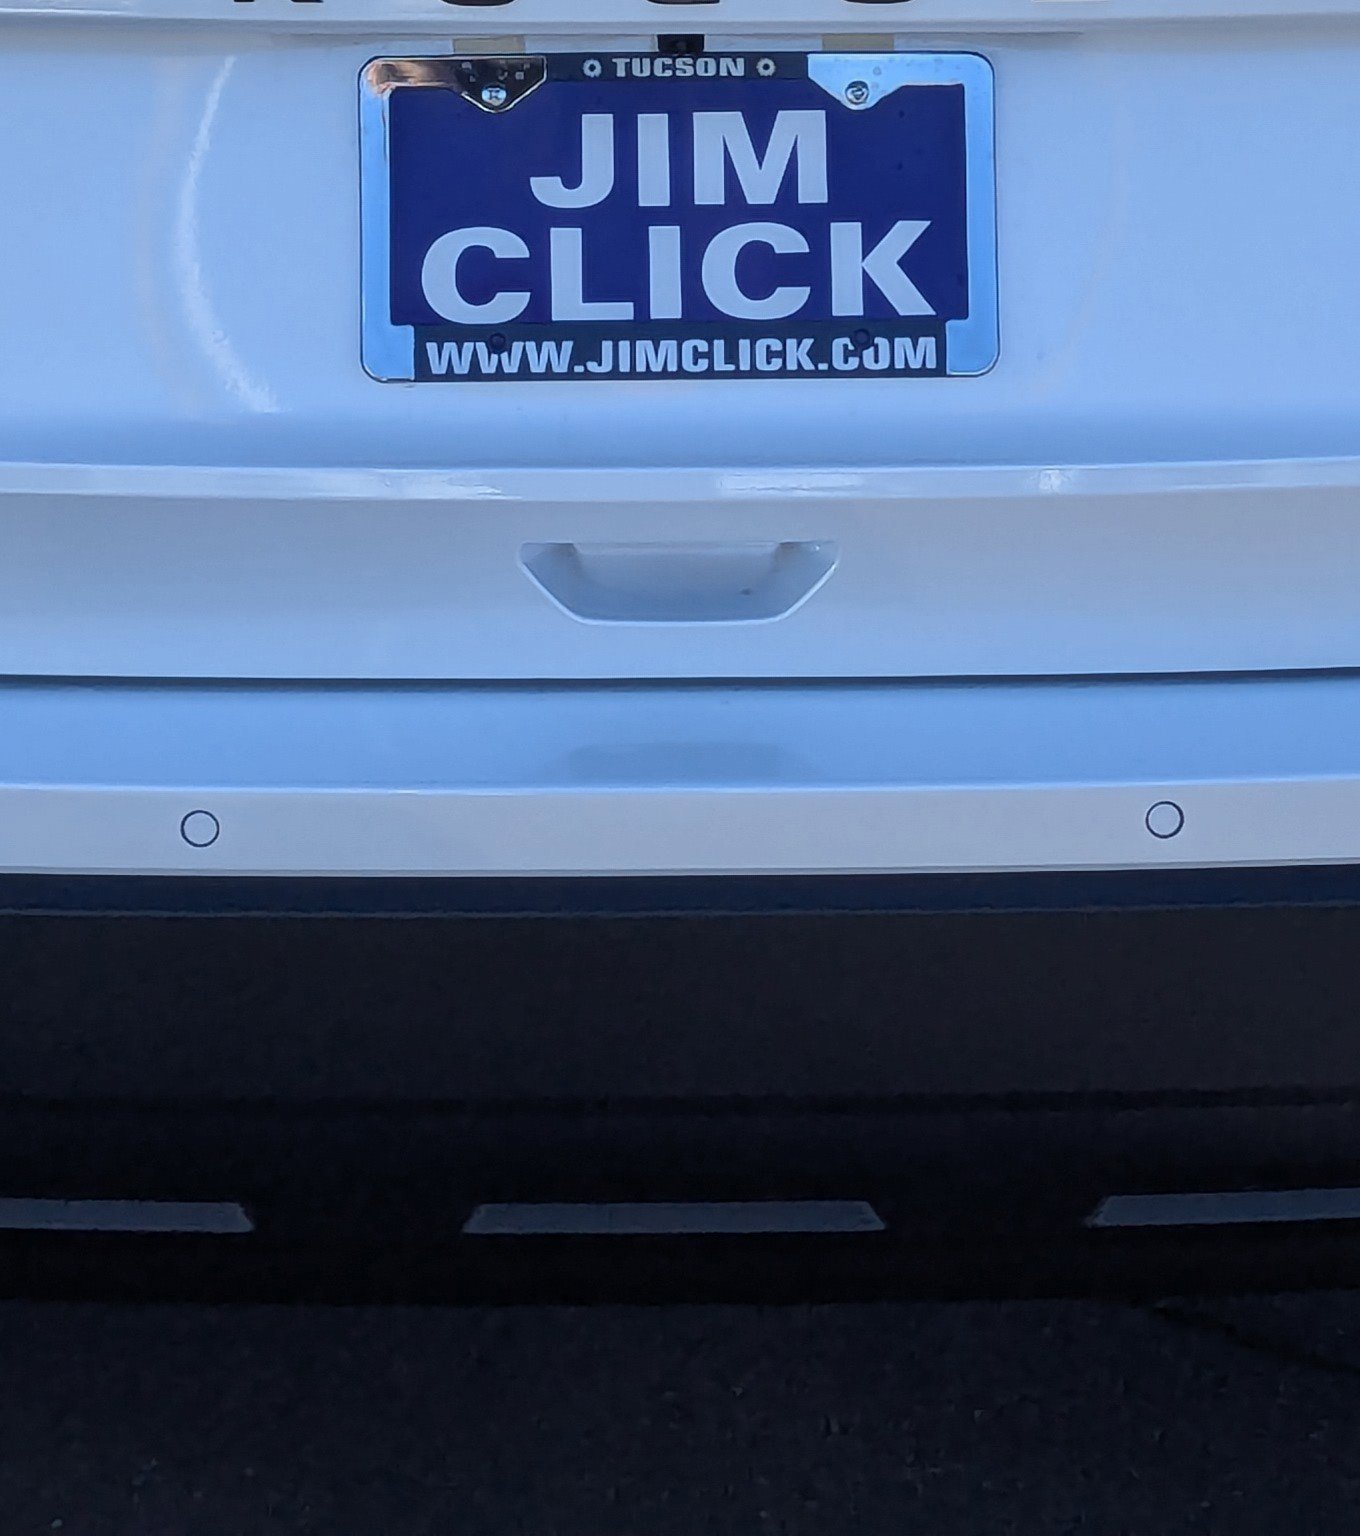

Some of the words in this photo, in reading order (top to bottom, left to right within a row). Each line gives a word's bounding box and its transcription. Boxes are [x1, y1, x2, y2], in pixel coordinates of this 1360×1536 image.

[612, 57, 745, 78] TUCSON
[529, 108, 830, 210] JIM
[420, 219, 938, 326] CLICK
[425, 336, 938, 376] WWW.JIMCLICK.COM
